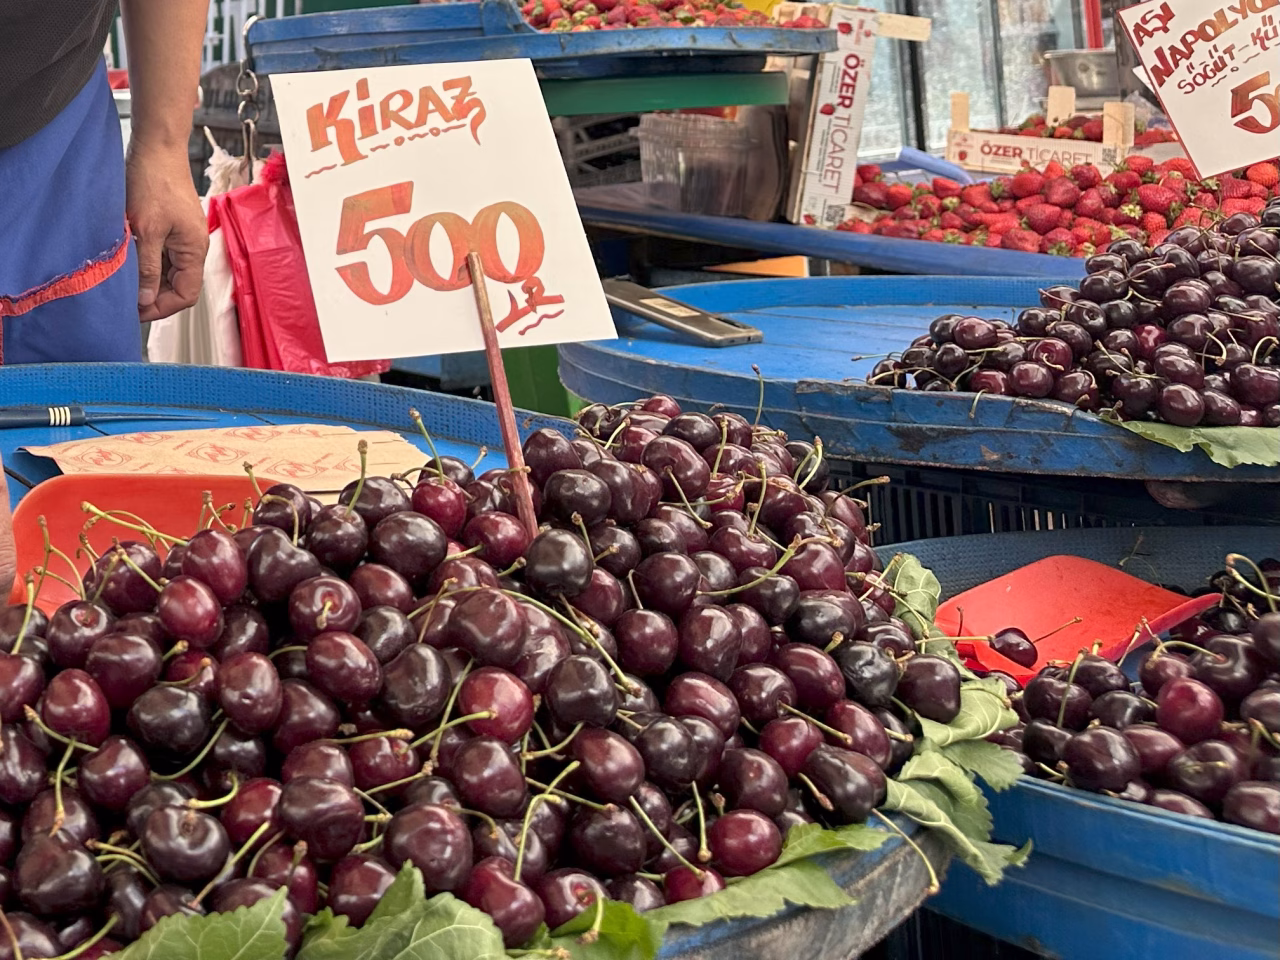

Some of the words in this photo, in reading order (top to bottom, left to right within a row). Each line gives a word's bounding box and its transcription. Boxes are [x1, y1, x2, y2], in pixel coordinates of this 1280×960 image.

[836, 53, 866, 109] ÖZER
[1230, 71, 1280, 134] 5
[822, 114, 854, 194] TİCARET
[980, 140, 1023, 158] ÖZER
[1026, 145, 1093, 165] TİCARET
[335, 180, 545, 306] 500
